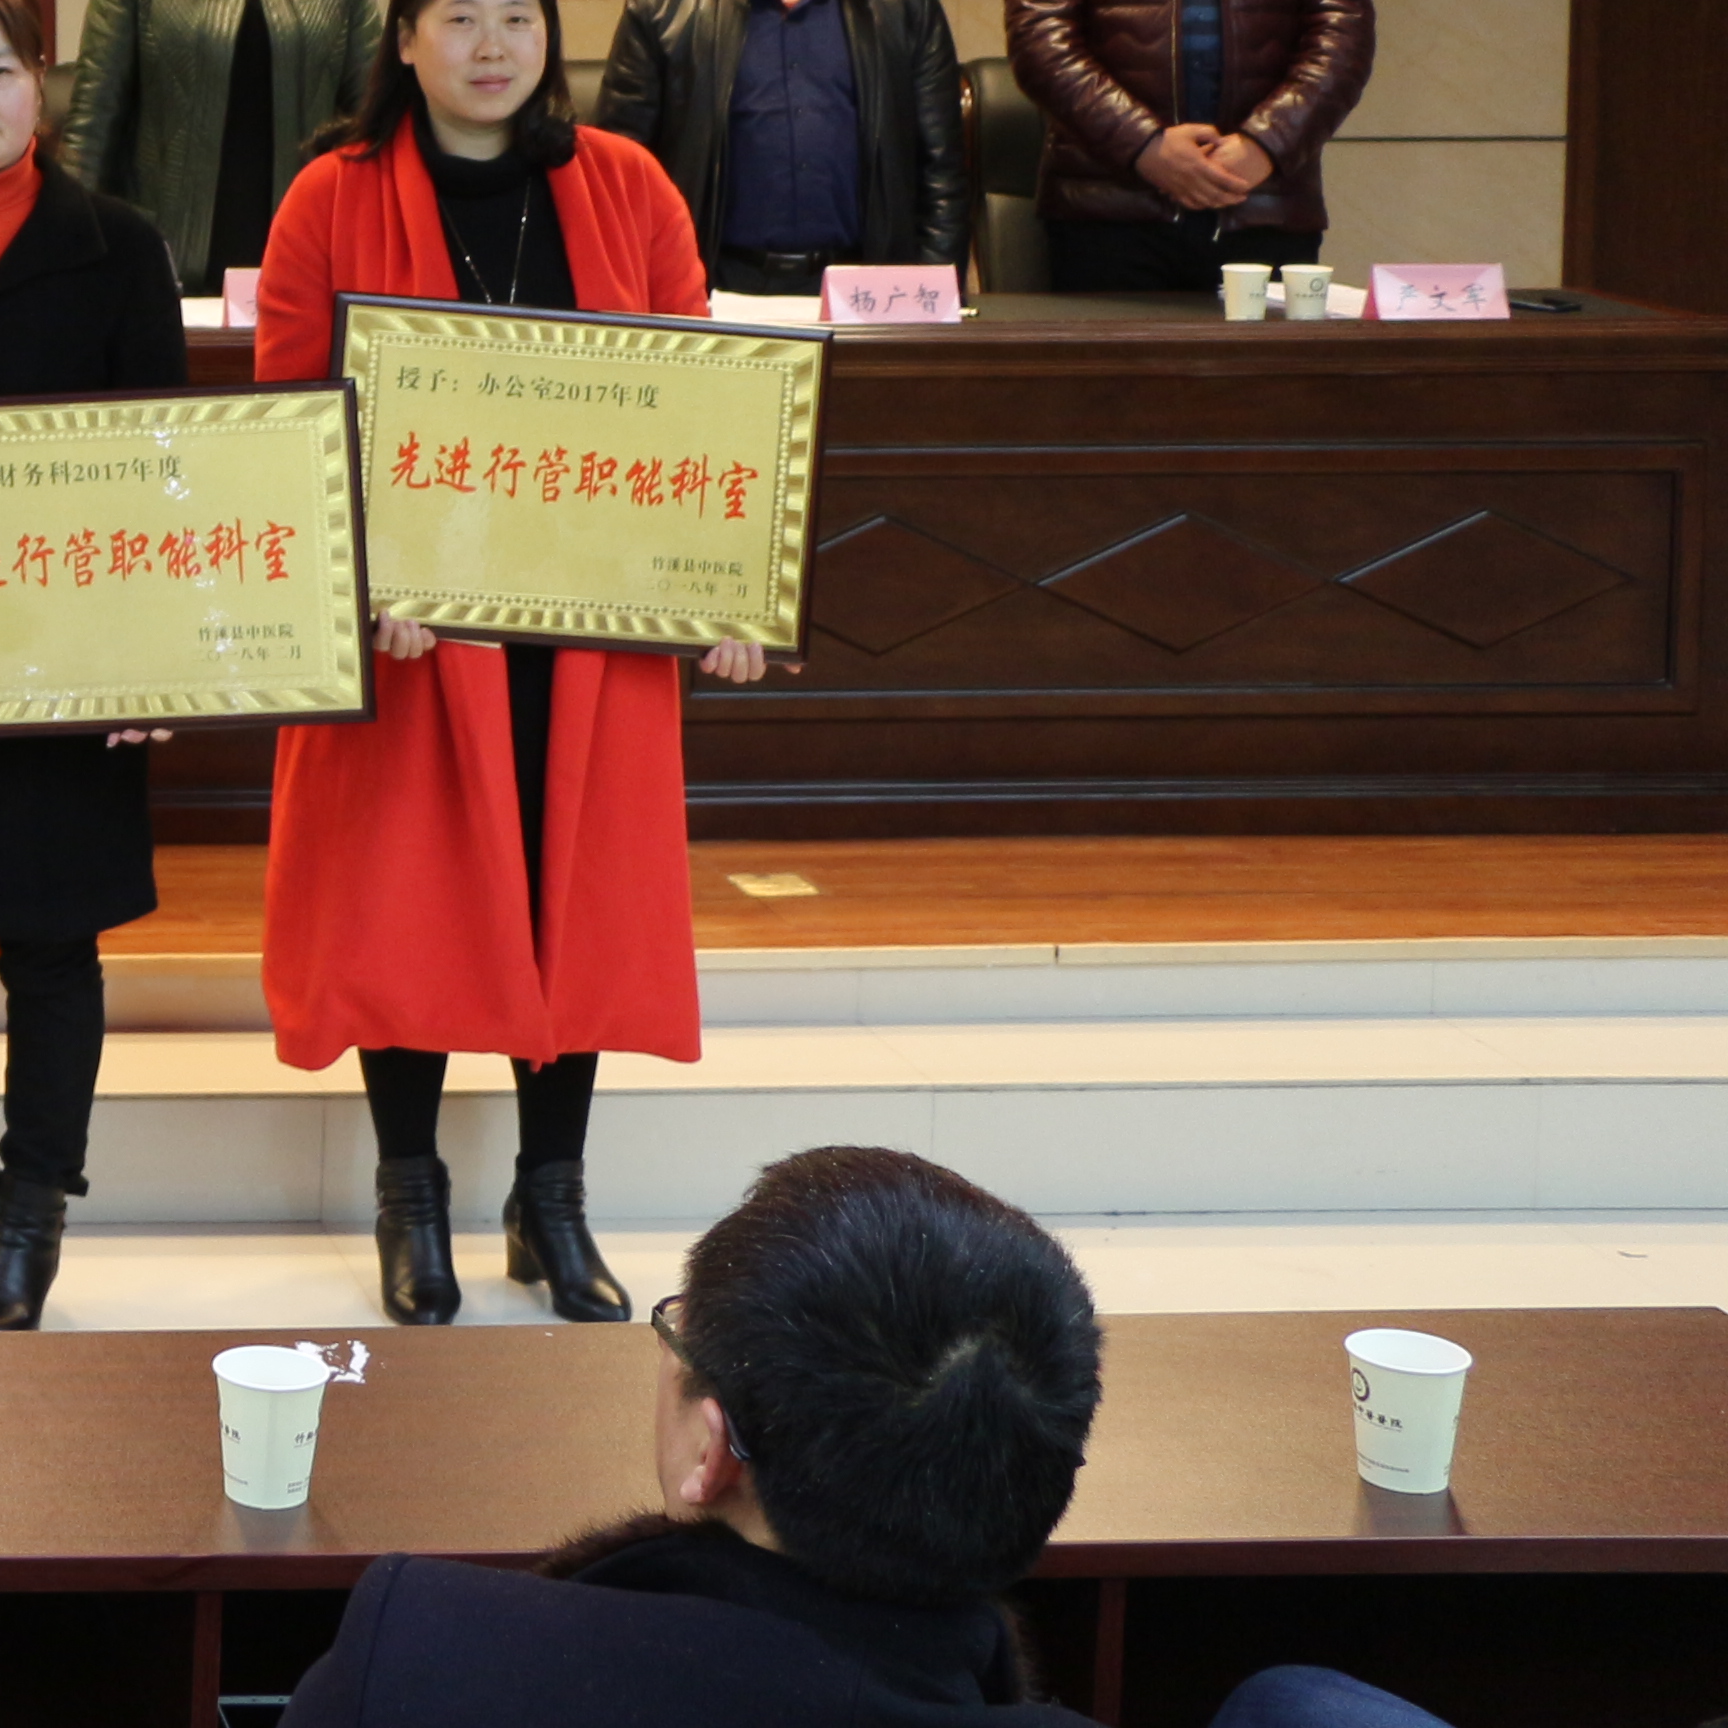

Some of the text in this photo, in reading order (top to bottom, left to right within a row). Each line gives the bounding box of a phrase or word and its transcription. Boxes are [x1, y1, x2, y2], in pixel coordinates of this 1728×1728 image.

[848, 283, 940, 314] 杨广智
[389, 430, 760, 521] 先进行管职能科室
